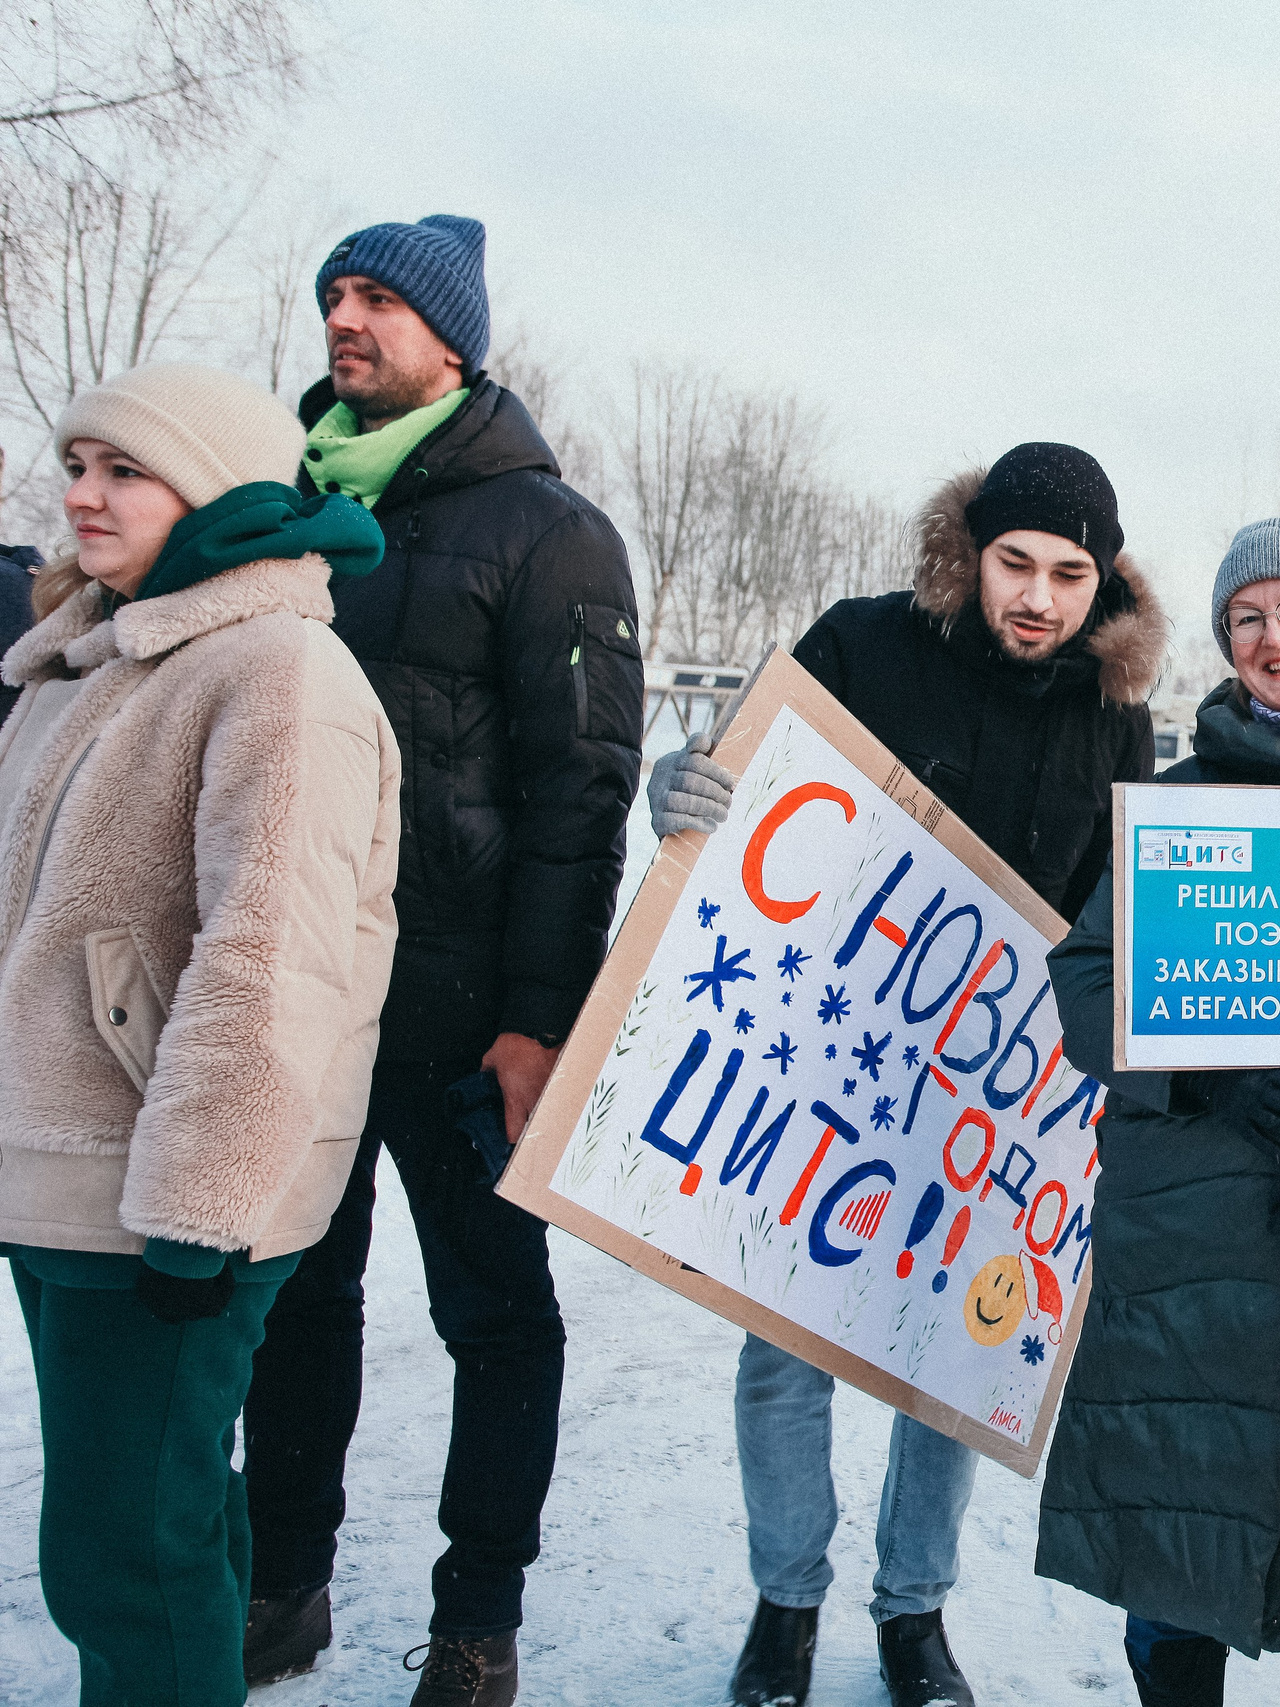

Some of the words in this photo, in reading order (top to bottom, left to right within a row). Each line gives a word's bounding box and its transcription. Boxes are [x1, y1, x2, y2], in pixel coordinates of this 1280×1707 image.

[741, 781, 857, 924] С
[1178, 884, 1279, 909] РЕШИЛ
[1149, 996, 1171, 1020] А
[1181, 996, 1280, 1020] БЕГАЮ
[902, 1062, 1092, 1284] ГОДОМ
[987, 1406, 1022, 1434] АЛИСА
